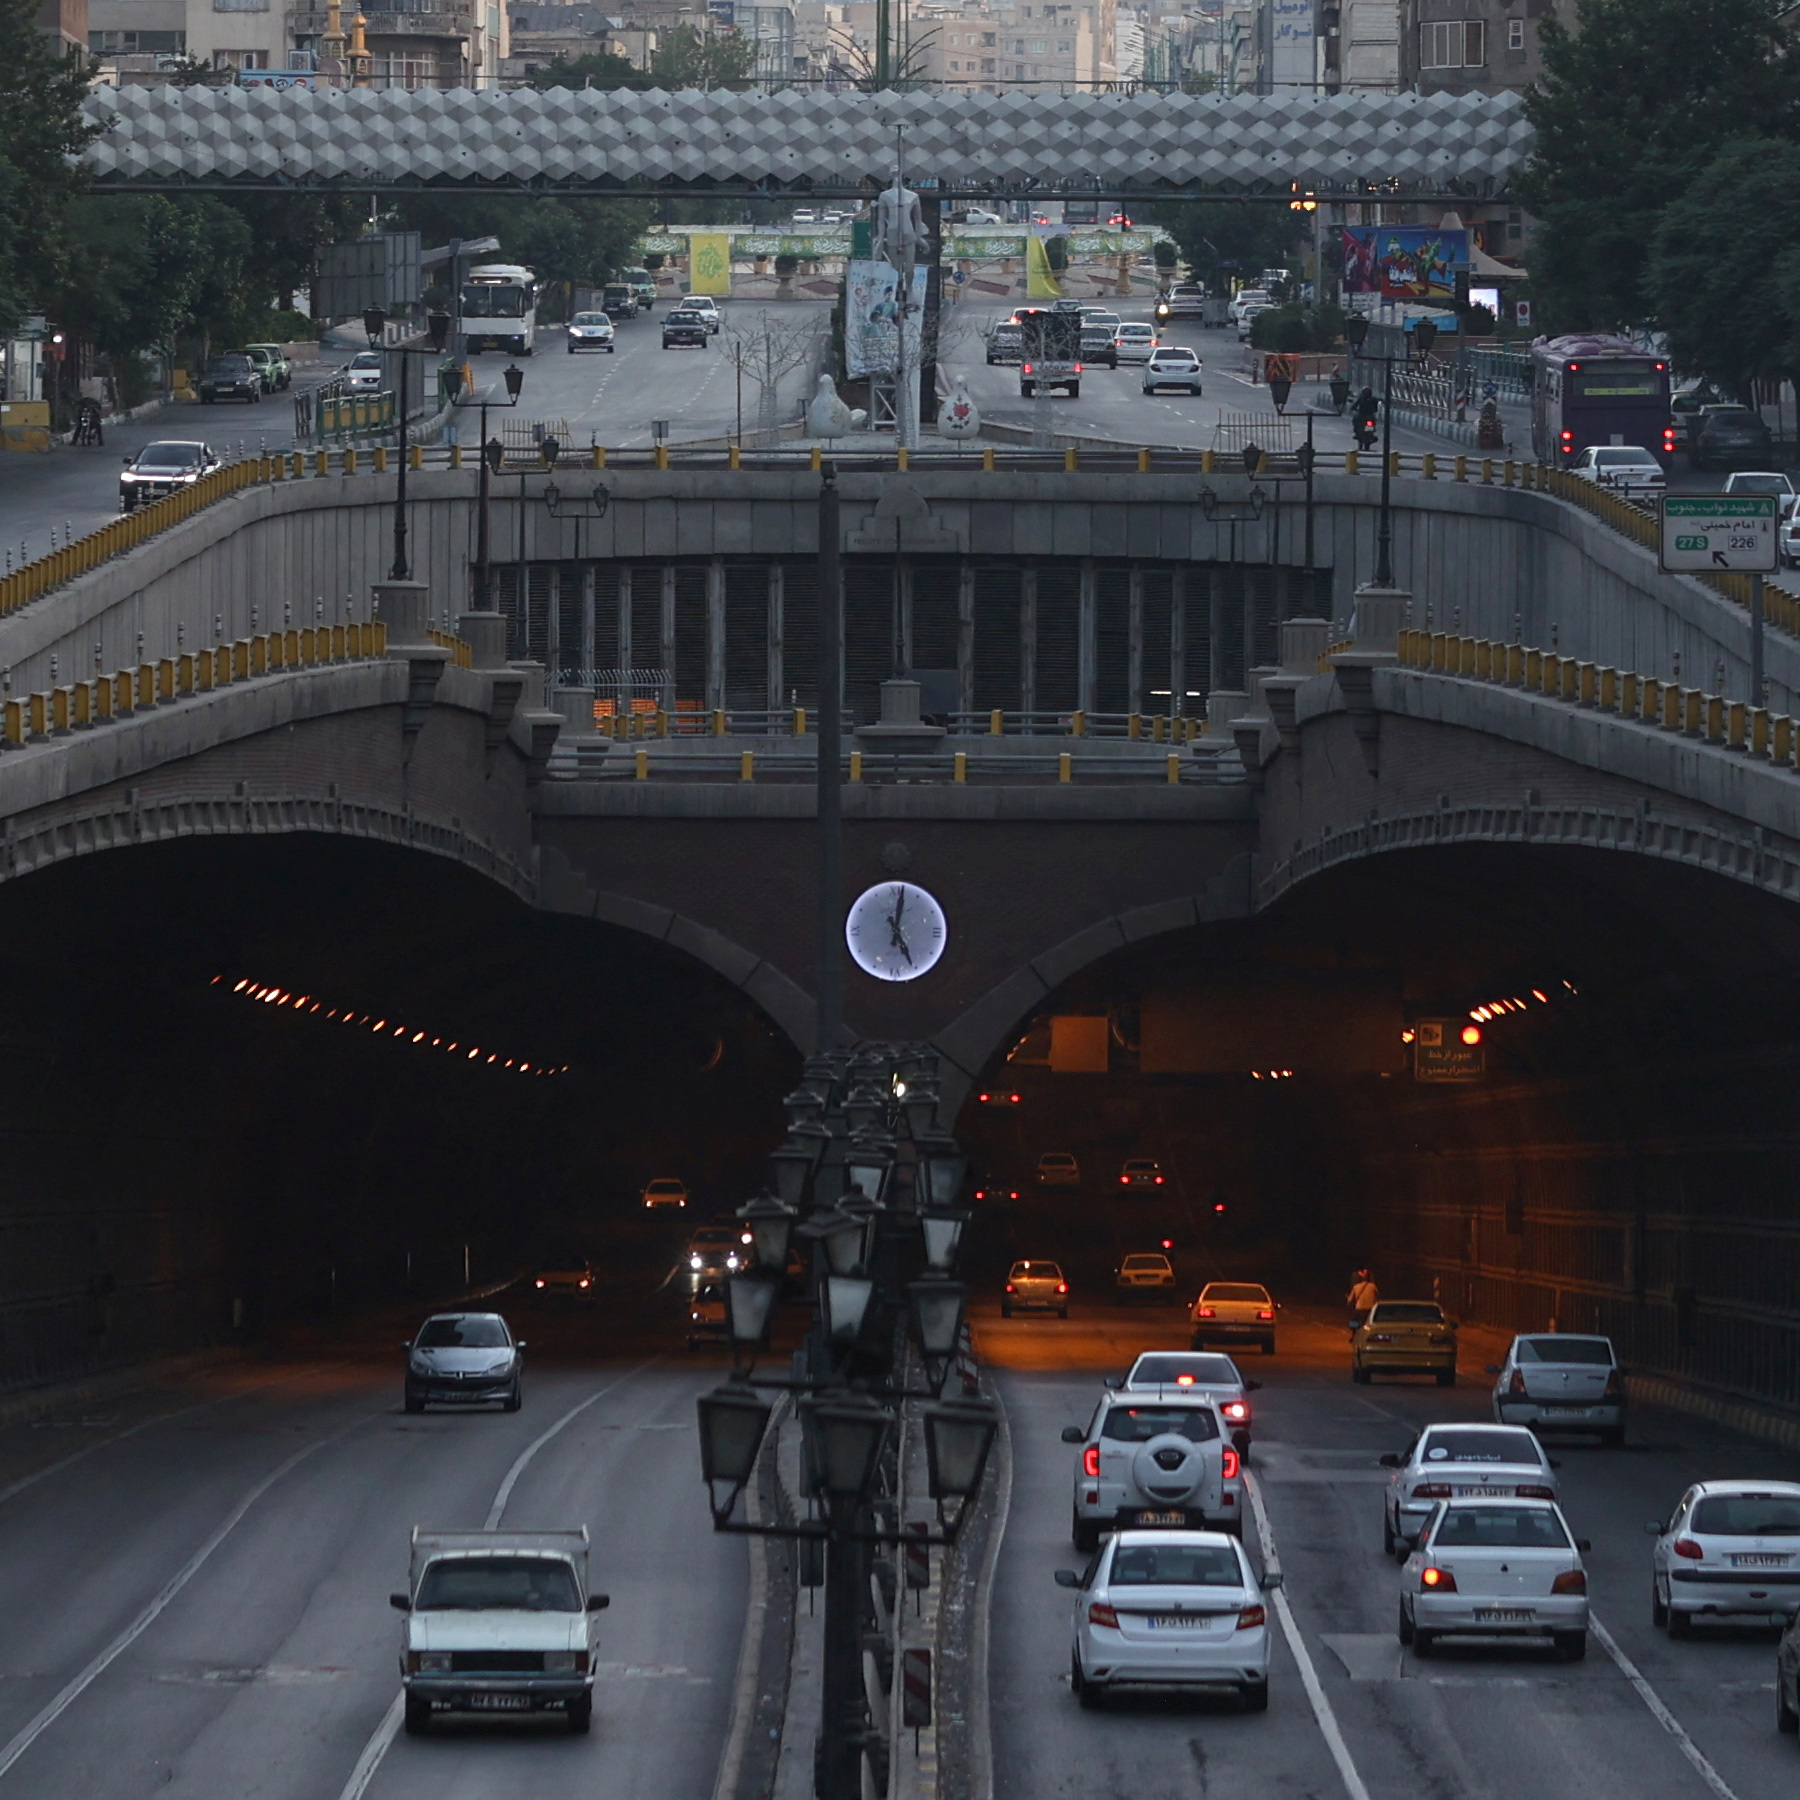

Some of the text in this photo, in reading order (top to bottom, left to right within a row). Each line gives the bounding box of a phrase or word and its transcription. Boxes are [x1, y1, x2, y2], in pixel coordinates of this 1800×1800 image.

[1678, 537, 1705, 547] 27 S
[1731, 538, 1754, 548] 226
